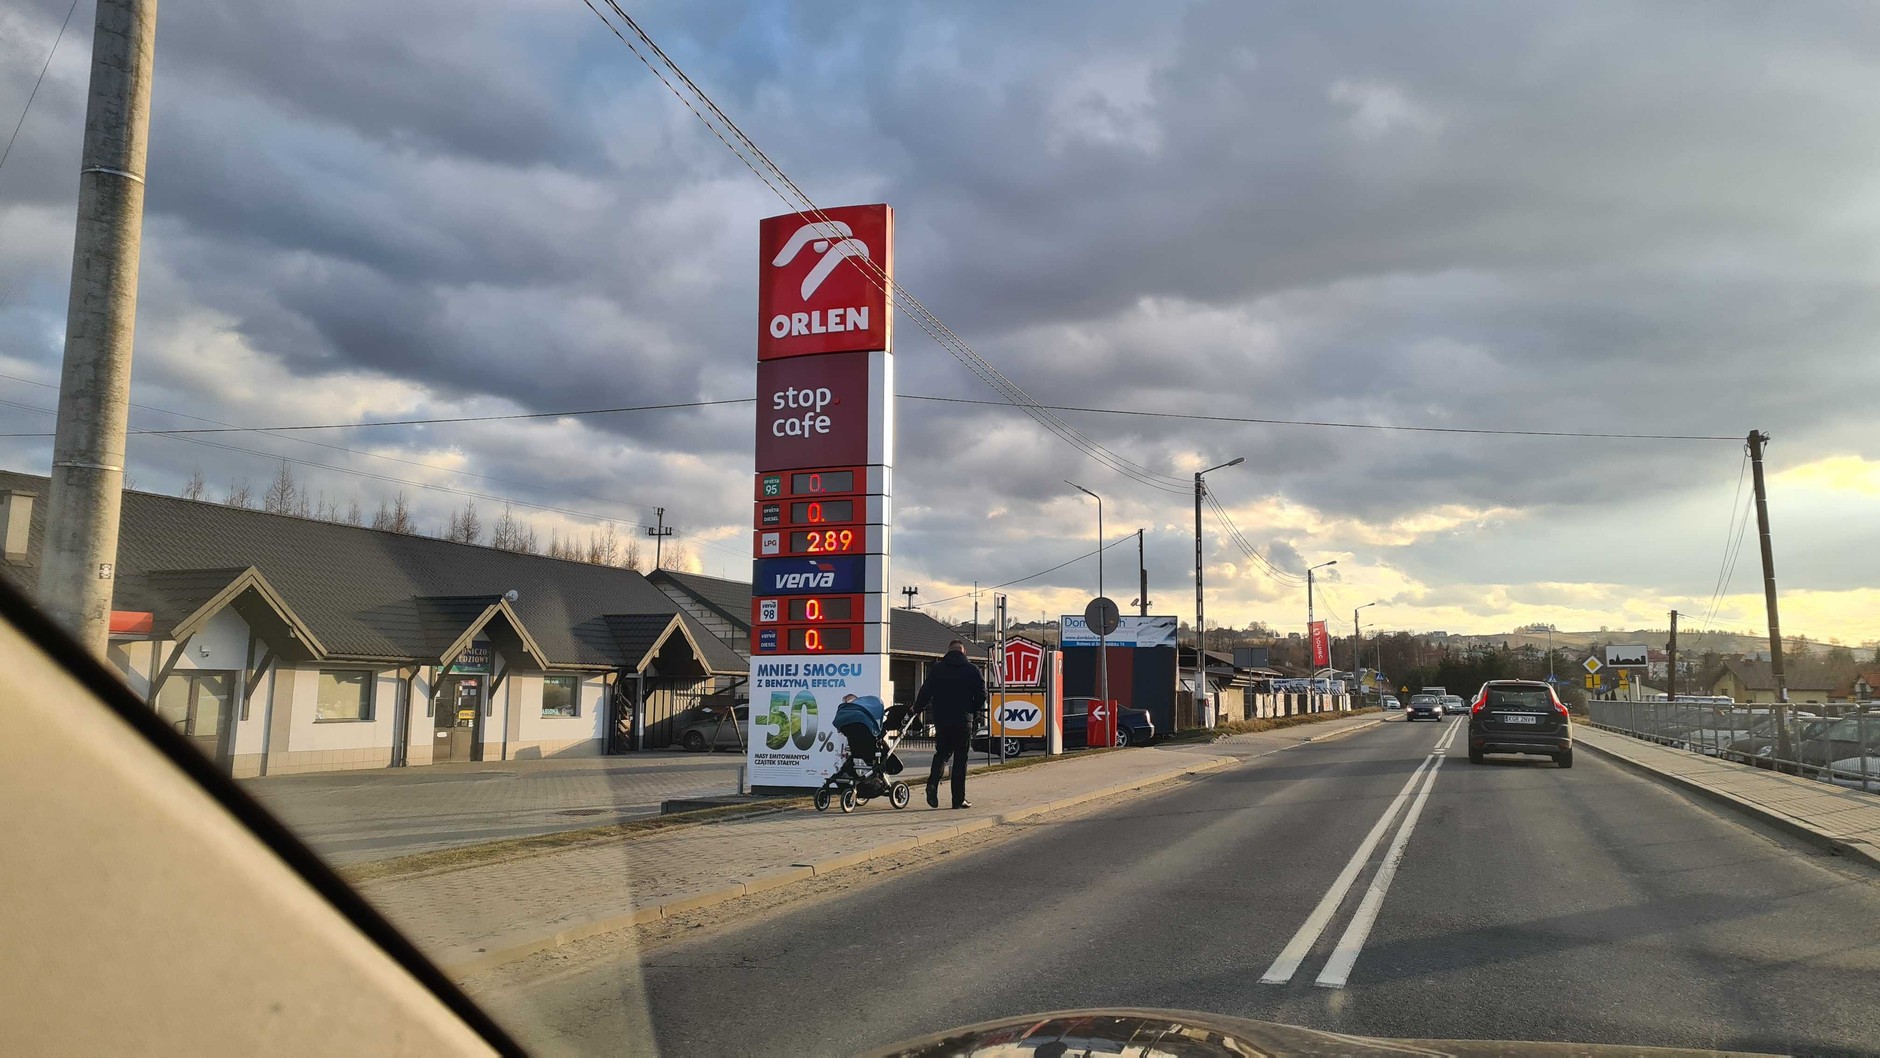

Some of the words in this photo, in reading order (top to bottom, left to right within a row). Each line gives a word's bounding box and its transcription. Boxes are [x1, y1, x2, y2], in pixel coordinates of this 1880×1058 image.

[770, 306, 869, 339] ORLEN
[773, 386, 832, 413] stop
[772, 411, 831, 438] cafe
[765, 484, 778, 495] 95
[764, 539, 777, 547] LPG
[806, 529, 853, 552] 2.89
[775, 571, 836, 589] verva
[763, 609, 775, 620] 98
[1065, 617, 1126, 627] Domh
[757, 663, 799, 677] MNIEJ
[803, 663, 862, 677] SMOGU
[757, 678, 763, 688] Z
[765, 678, 809, 690] BENZYNĄ
[811, 678, 846, 688] EFECTA
[755, 690, 834, 752] -50%
[997, 708, 1038, 722] DKV
